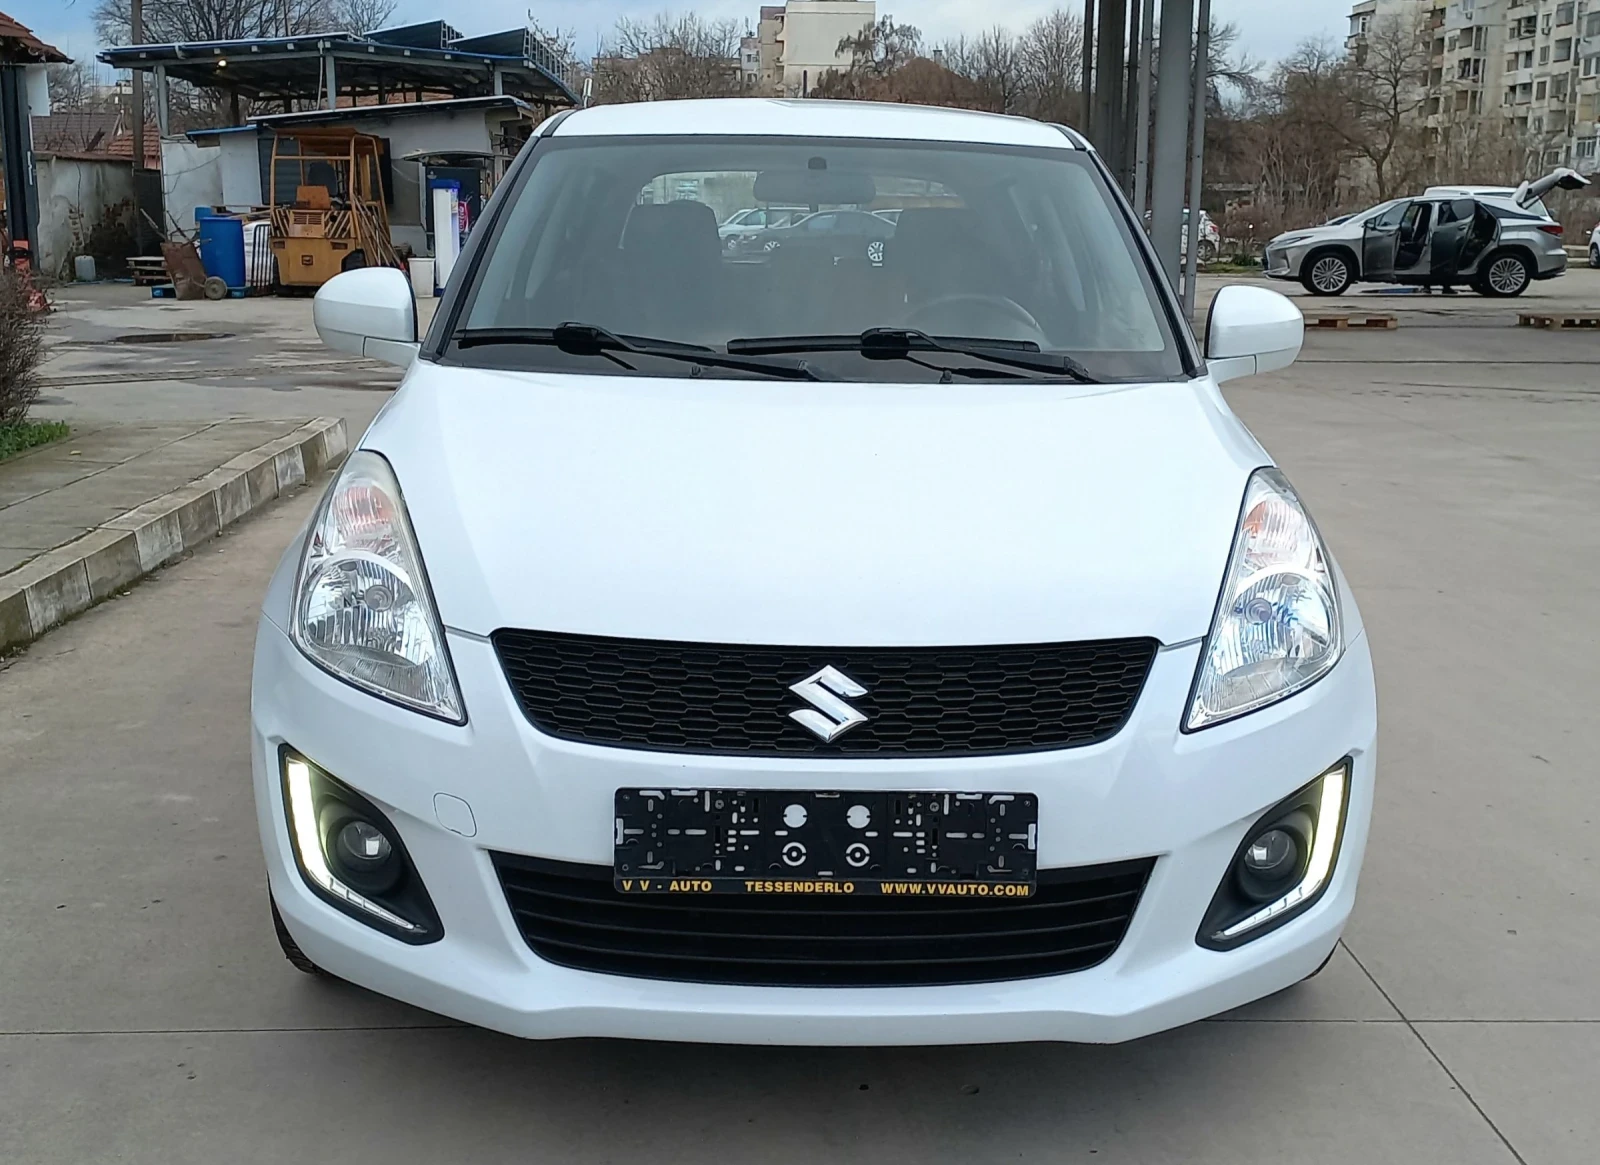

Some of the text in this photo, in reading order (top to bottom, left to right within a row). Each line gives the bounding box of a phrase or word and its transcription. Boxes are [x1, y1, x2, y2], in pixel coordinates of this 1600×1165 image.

[622, 880, 633, 891] V
[639, 880, 650, 891] V
[669, 880, 712, 892] AUTO
[744, 881, 855, 893] TESSENDERLO
[880, 882, 1029, 896] WWW.VVAUTO.COM
